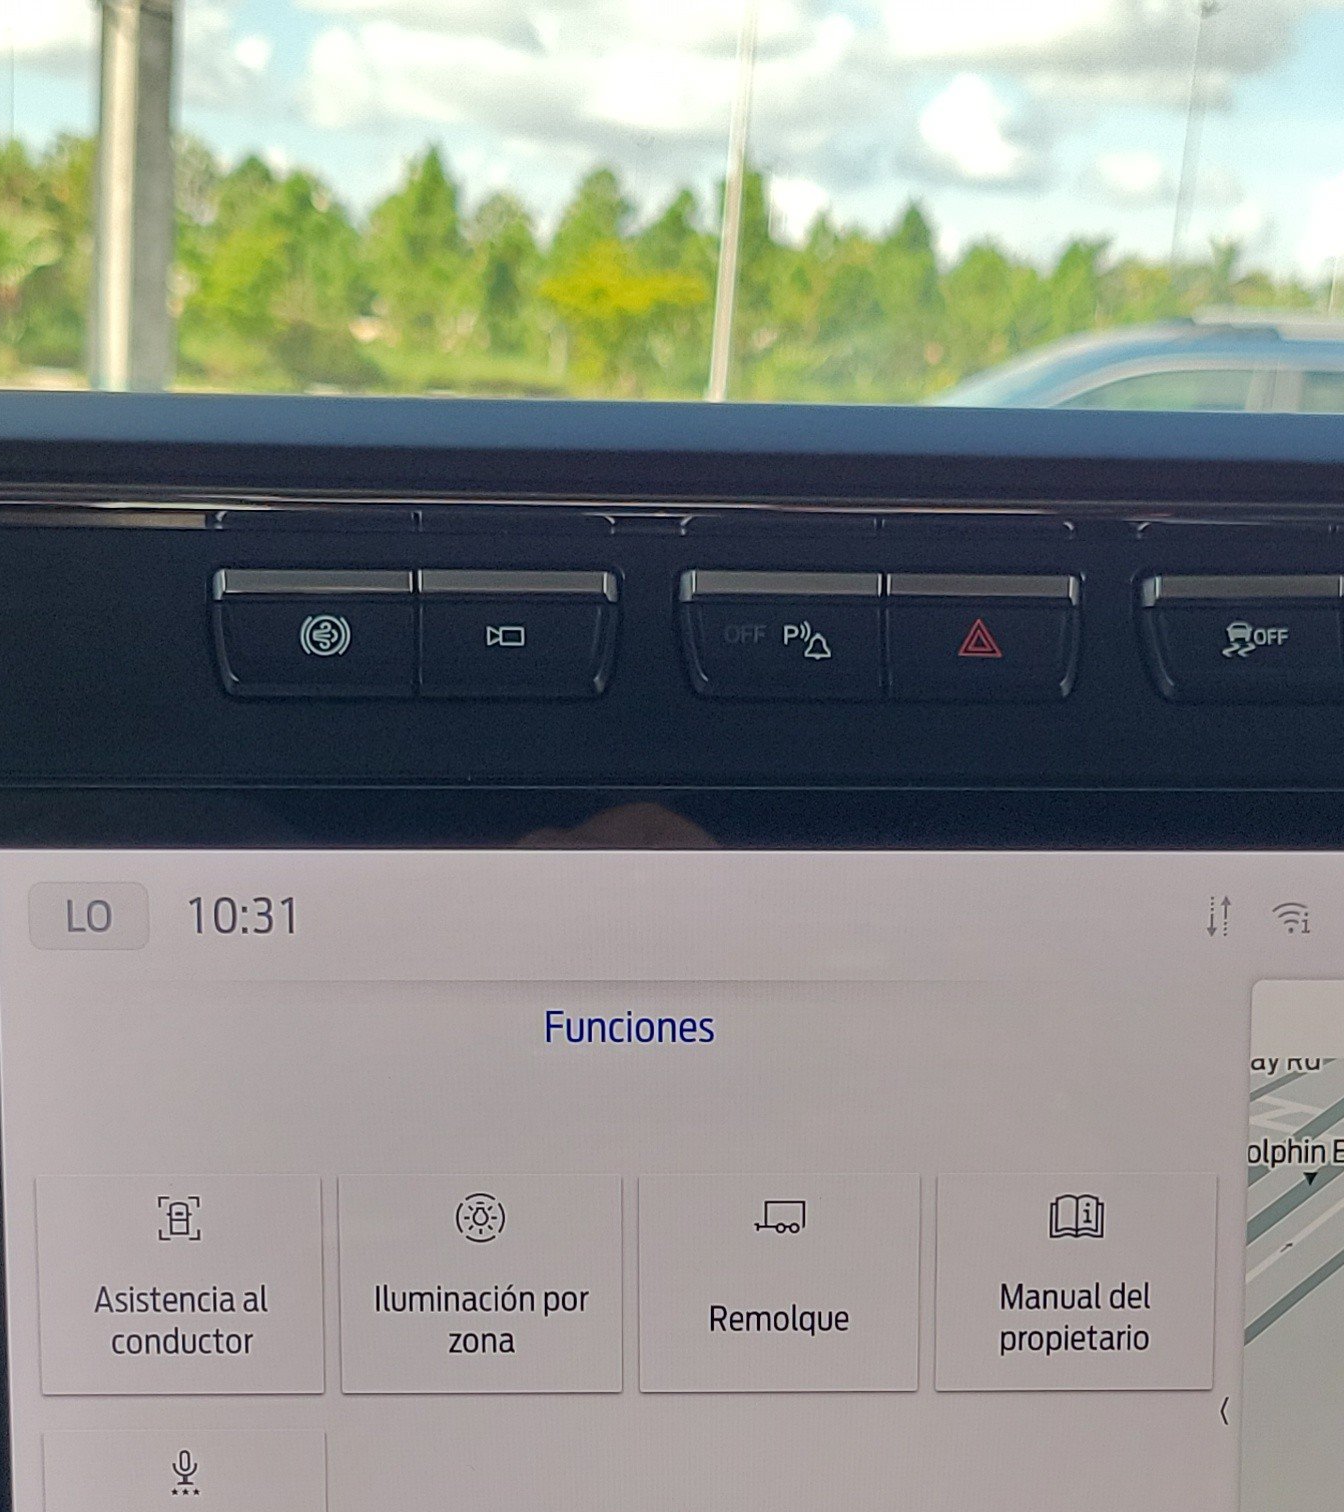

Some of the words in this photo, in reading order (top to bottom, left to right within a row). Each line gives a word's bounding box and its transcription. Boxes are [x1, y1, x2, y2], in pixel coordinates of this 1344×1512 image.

[1253, 628, 1289, 646] OFF
[65, 899, 113, 932] LO
[188, 896, 297, 935] 10:31
[544, 1009, 715, 1044] Funciones
[1251, 1057, 1278, 1075] ay
[1247, 1138, 1326, 1168] olphin
[95, 1286, 235, 1313] Asistencia
[243, 1285, 268, 1313] al
[375, 1284, 534, 1313] Iluminación
[544, 1290, 589, 1316] por
[1000, 1282, 1100, 1310] Manual
[1110, 1281, 1150, 1310] del
[709, 1304, 849, 1336] Remolque
[111, 1326, 253, 1355] conductor
[448, 1330, 515, 1354] zona
[1000, 1324, 1150, 1355] propietario
